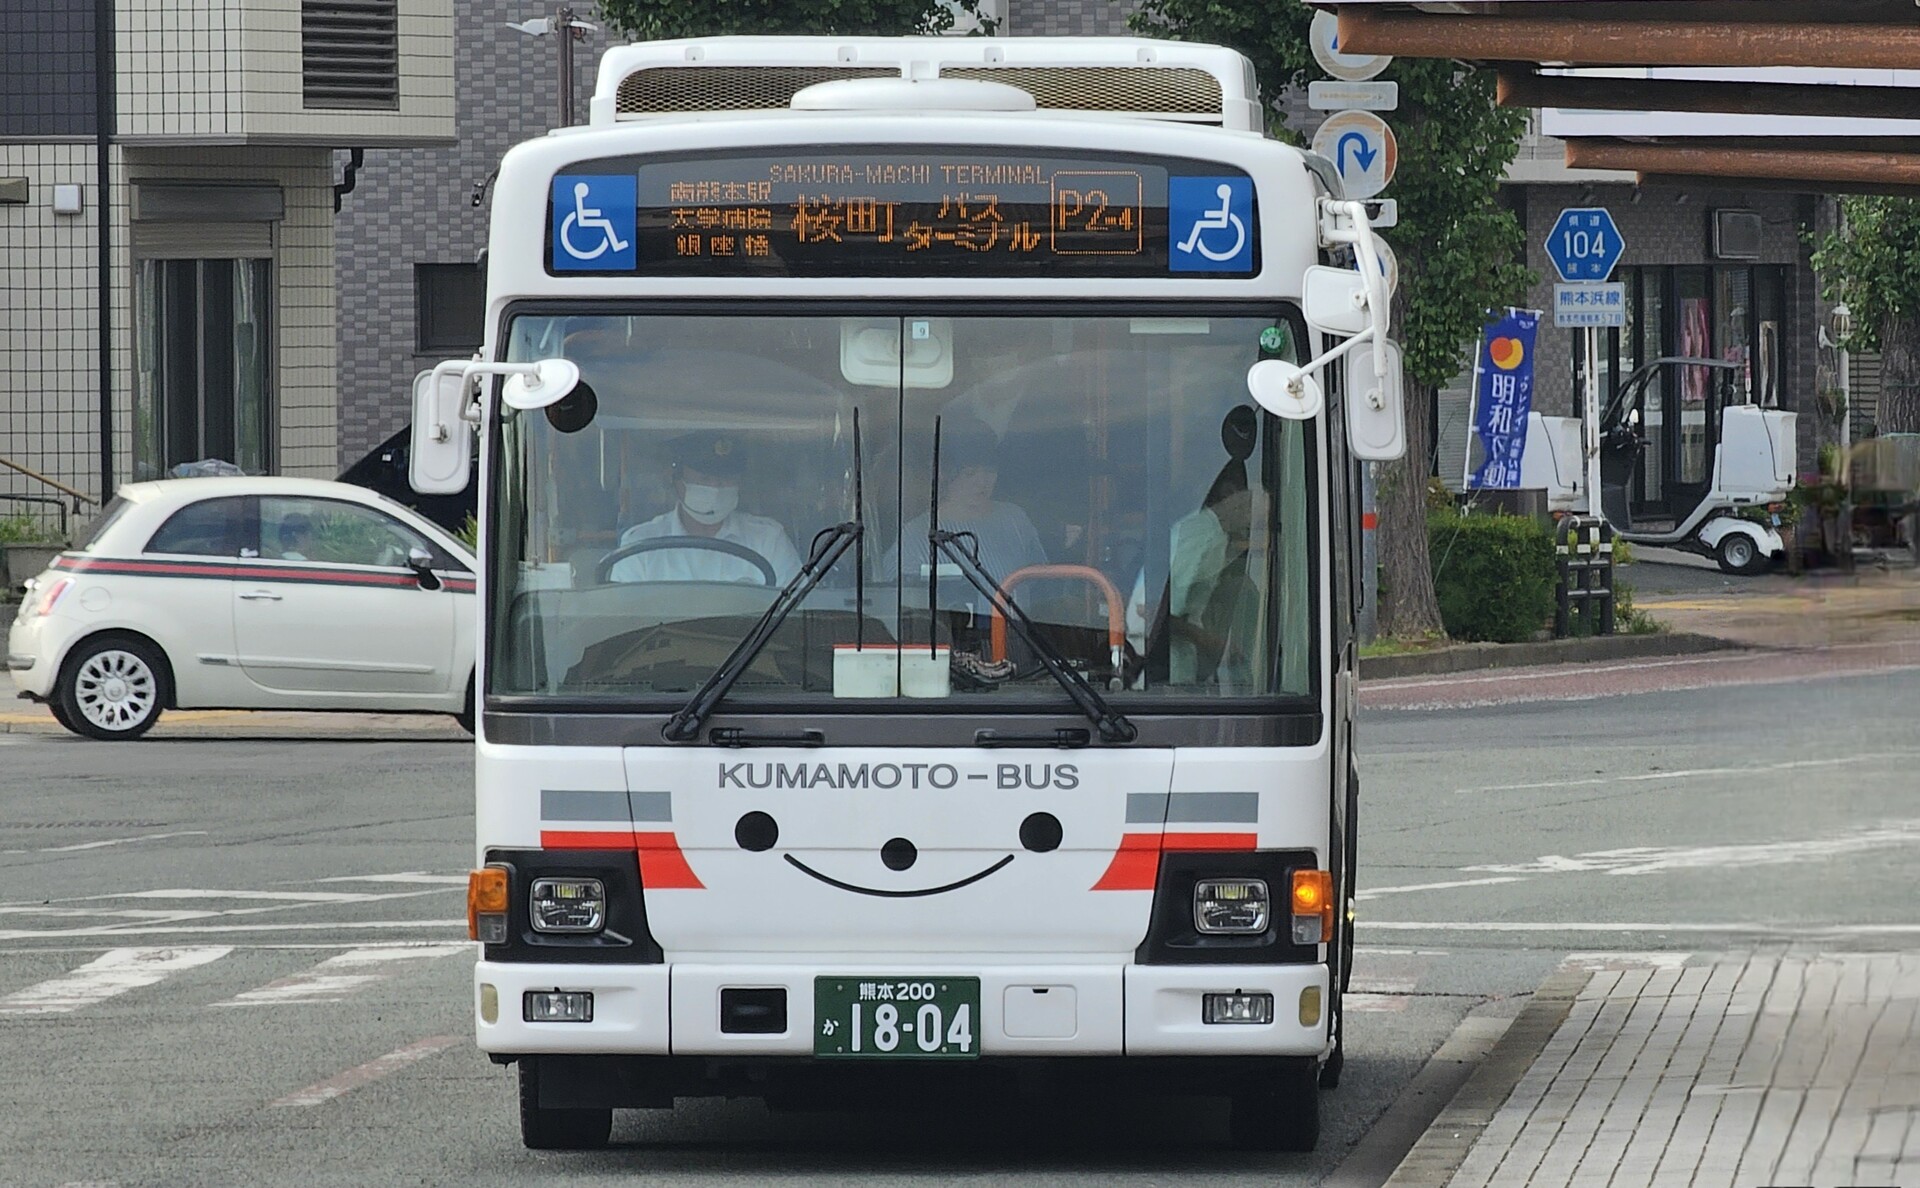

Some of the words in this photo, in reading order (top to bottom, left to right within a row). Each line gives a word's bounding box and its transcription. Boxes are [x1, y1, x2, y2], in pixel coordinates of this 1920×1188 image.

[769, 163, 931, 185] SAKURA-MACHI
[940, 163, 1049, 185] TERMINAL
[670, 180, 772, 203] 南熊本駅
[937, 191, 1005, 222] バス
[670, 207, 772, 230] 大学病院
[789, 193, 902, 244] 桜町
[1058, 188, 1134, 231] P2-4
[903, 220, 1041, 252] ターミナル
[1563, 229, 1606, 259] 104
[1560, 290, 1620, 306] 熊本浜線
[822, 1018, 840, 1036] か
[850, 1002, 973, 1053] 18-04
